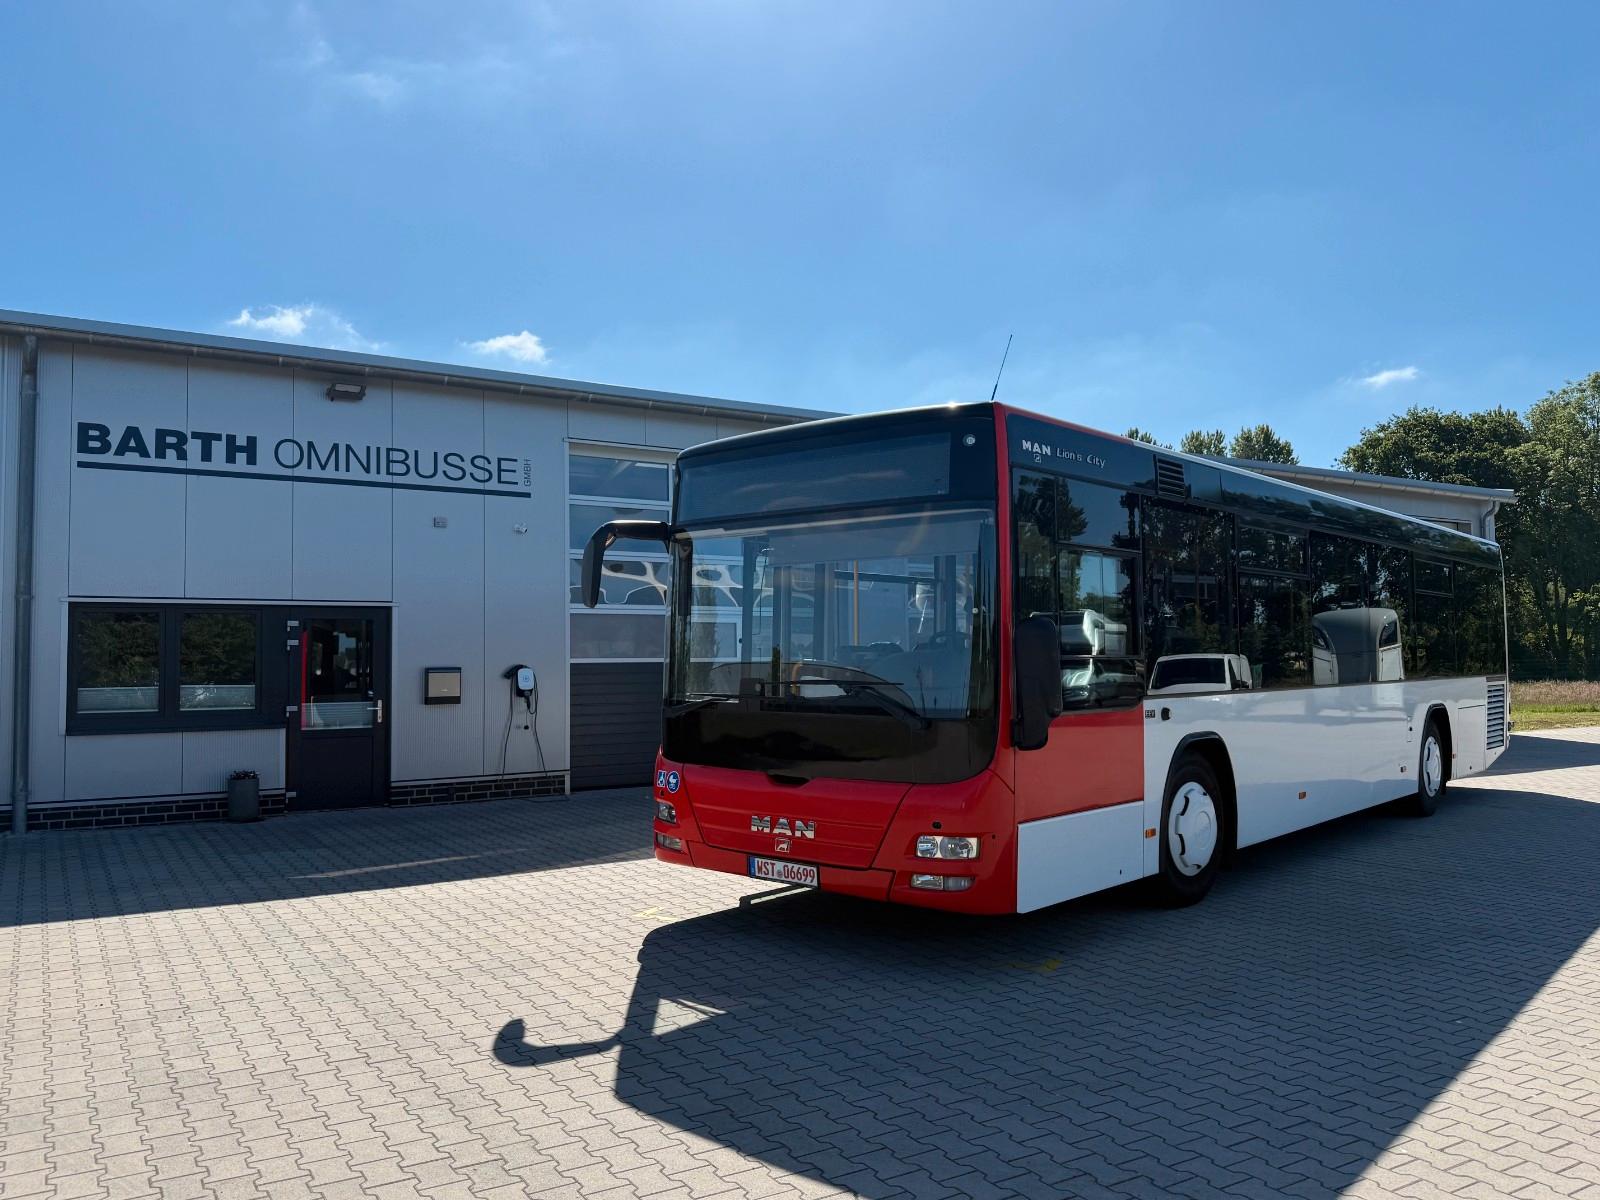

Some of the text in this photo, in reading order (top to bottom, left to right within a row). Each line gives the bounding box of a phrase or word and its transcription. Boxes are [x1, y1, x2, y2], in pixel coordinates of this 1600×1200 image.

[77, 422, 520, 486] BARTH OMNIBUSSE
[1022, 439, 1106, 468] MAN Lion's City
[523, 458, 532, 487] GMBH
[751, 815, 815, 839] MAN
[757, 859, 815, 884] WST 06699
